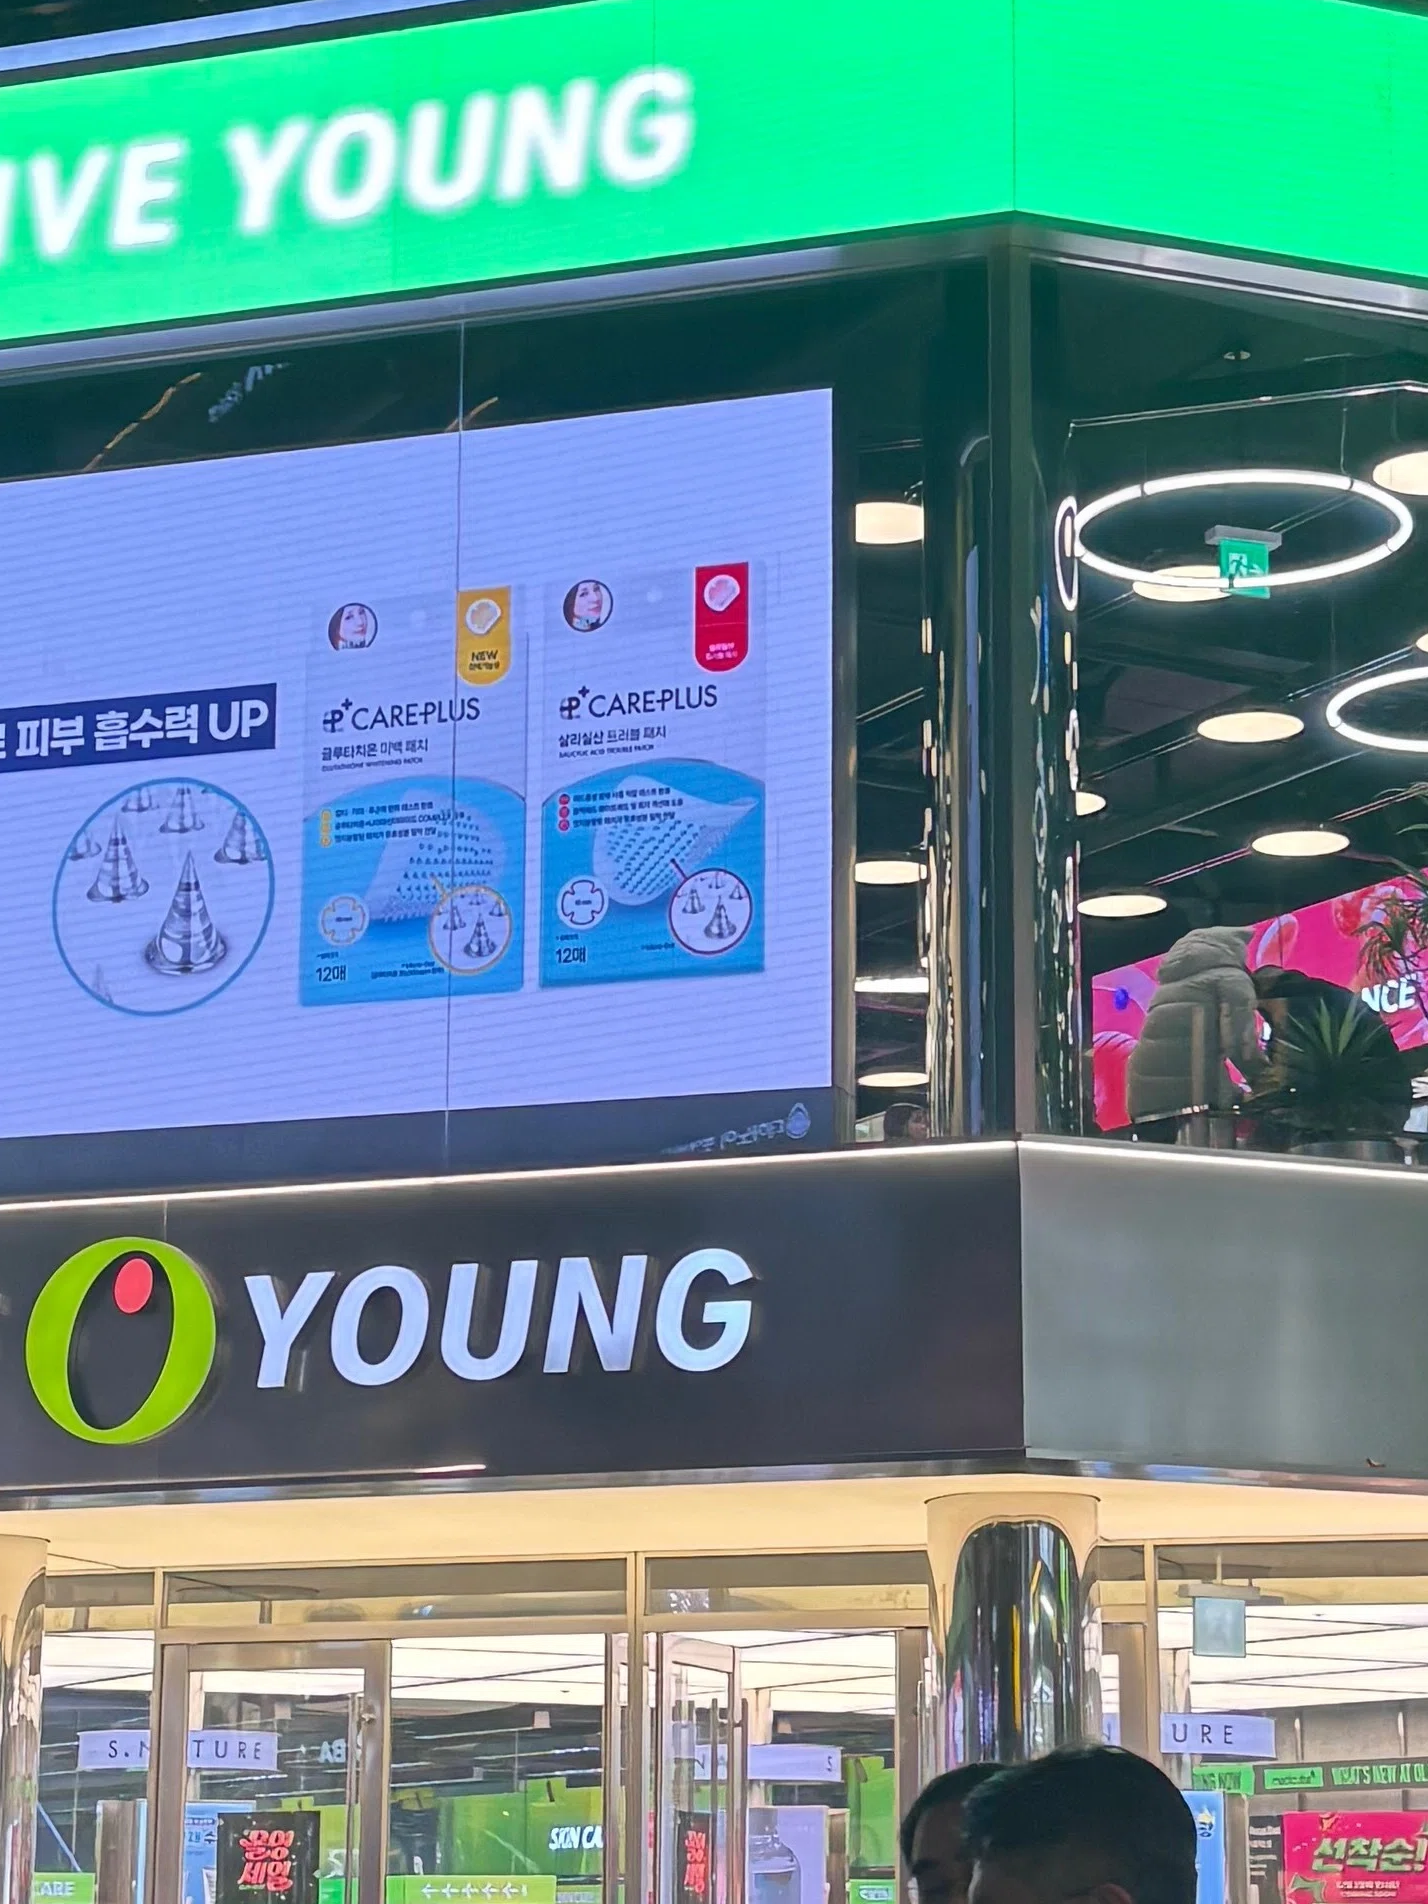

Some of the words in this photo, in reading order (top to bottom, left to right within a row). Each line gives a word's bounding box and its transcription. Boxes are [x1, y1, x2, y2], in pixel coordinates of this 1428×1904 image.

[224, 64, 696, 236] YOUNG
[471, 649, 499, 663] NEW
[16, 717, 85, 758] 피부
[93, 701, 199, 753] 흡수력
[207, 699, 270, 742] UP
[380, 740, 404, 756] 미백
[555, 945, 587, 964] 12매
[315, 964, 347, 982] 12매
[242, 1246, 756, 1390] YOUNG
[1311, 1837, 1428, 1873] 선착순!
